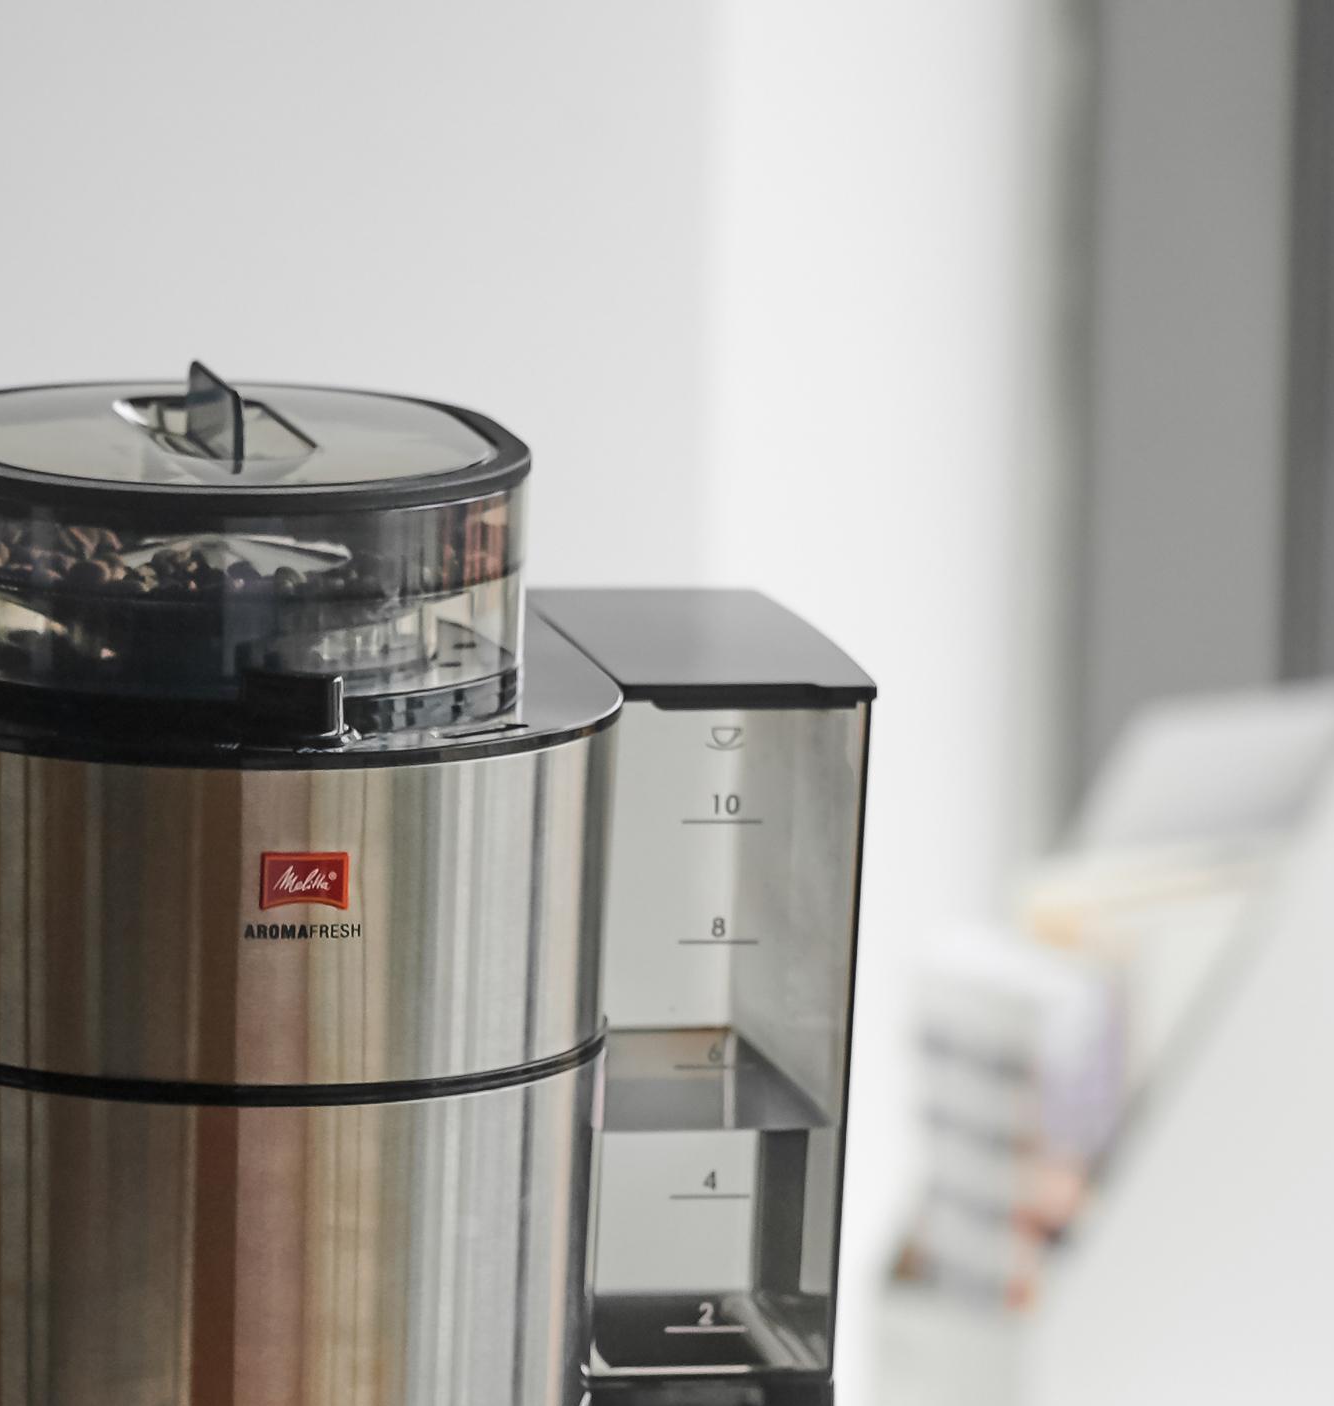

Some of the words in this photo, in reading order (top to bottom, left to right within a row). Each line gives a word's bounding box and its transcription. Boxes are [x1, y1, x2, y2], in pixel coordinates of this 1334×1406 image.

[713, 793, 741, 815] 10
[244, 923, 361, 939] AROMAFRESH
[711, 916, 726, 938] 8
[707, 1043, 722, 1062] 6
[703, 1169, 716, 1190] 4
[698, 1301, 714, 1325] 2
